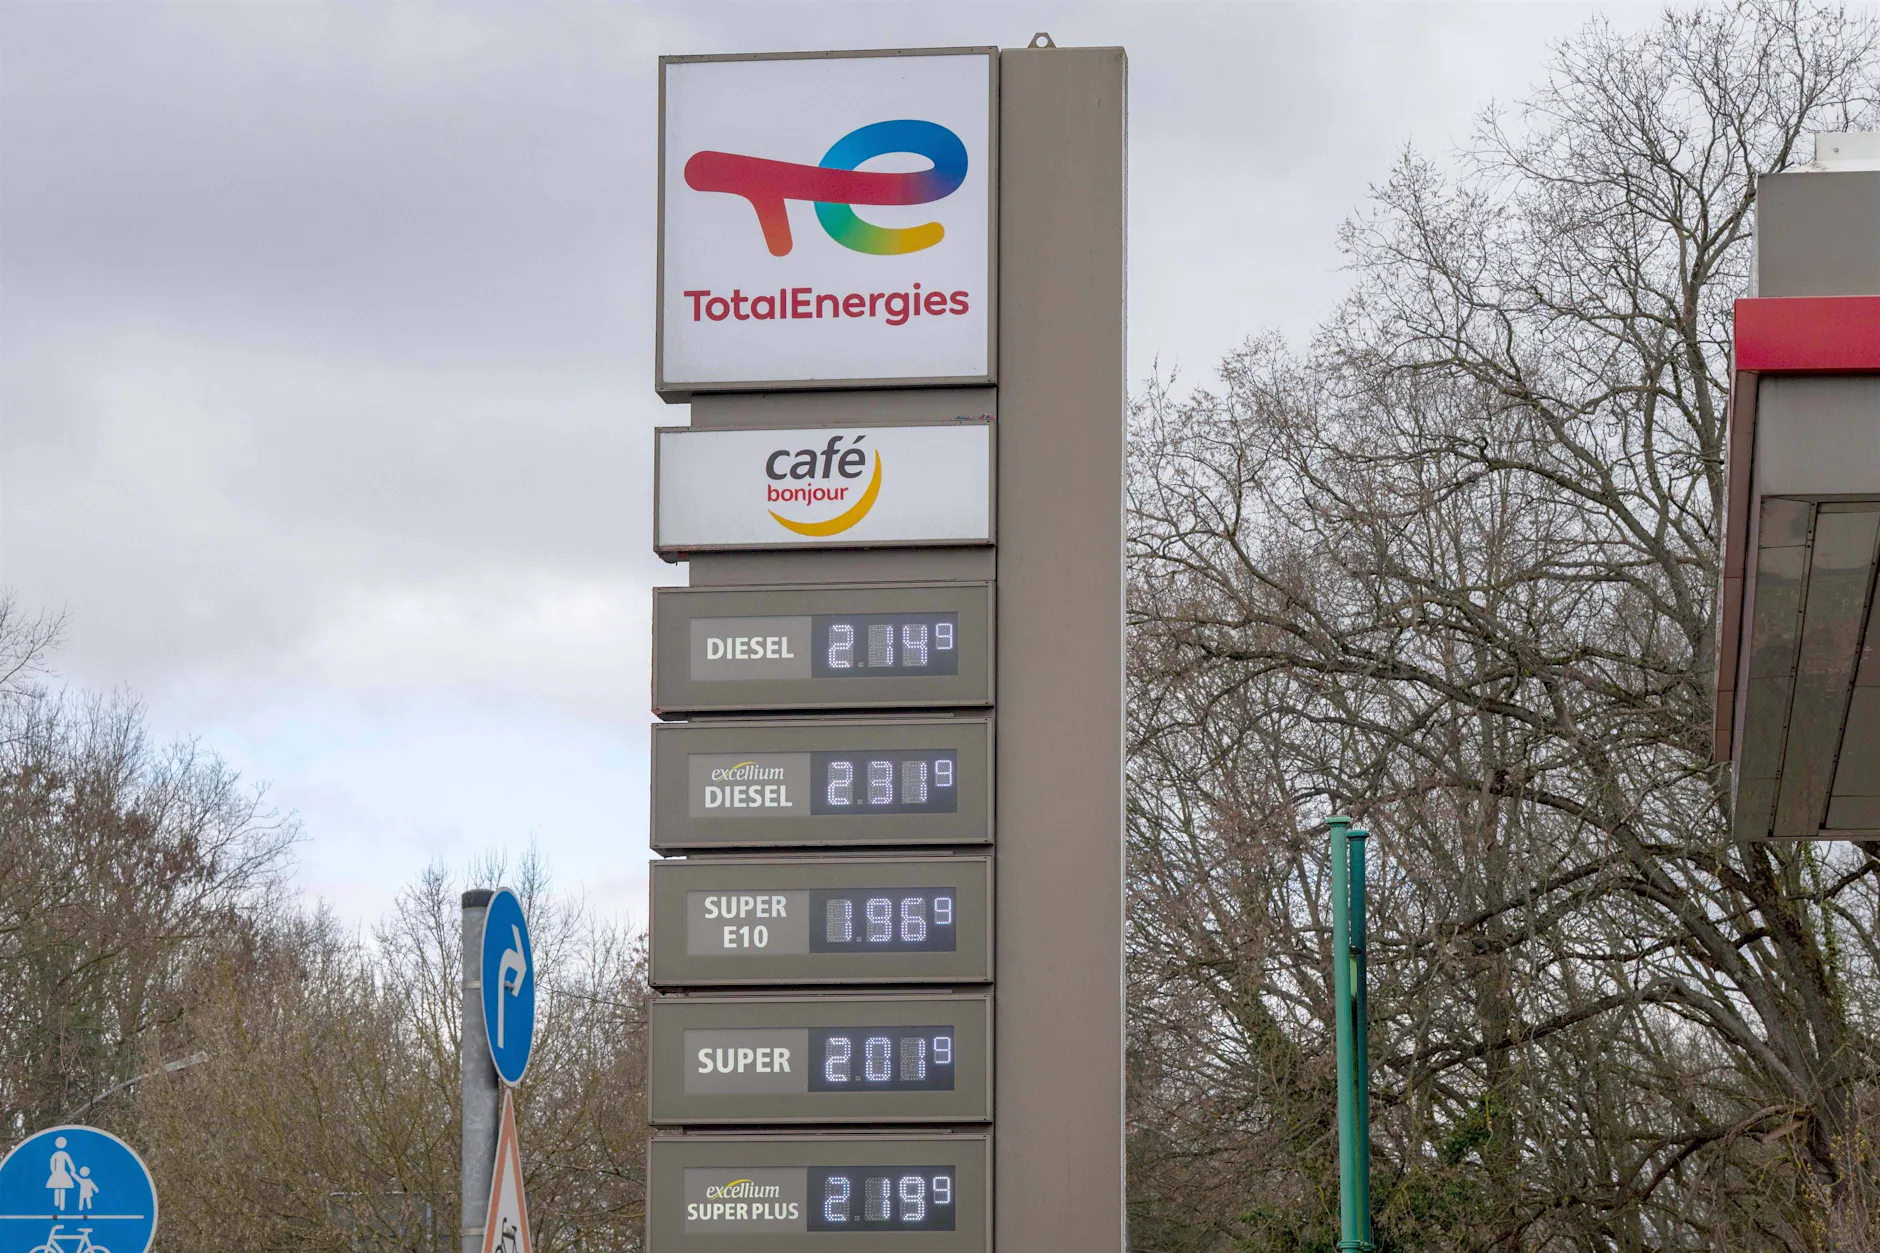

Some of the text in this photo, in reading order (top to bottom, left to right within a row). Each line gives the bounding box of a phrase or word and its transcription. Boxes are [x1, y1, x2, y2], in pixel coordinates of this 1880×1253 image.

[683, 282, 970, 326] TotalEnergies
[765, 435, 867, 481] café
[766, 483, 849, 506] bonjour
[706, 636, 795, 660] DIESEL
[711, 762, 785, 782] excellium
[704, 785, 793, 809] DIESEL
[704, 895, 788, 919] SUPER
[722, 925, 769, 948] E10
[697, 1047, 792, 1074] SUPER
[705, 1179, 780, 1200] excellium
[687, 1202, 799, 1220] SUPER PLUS
